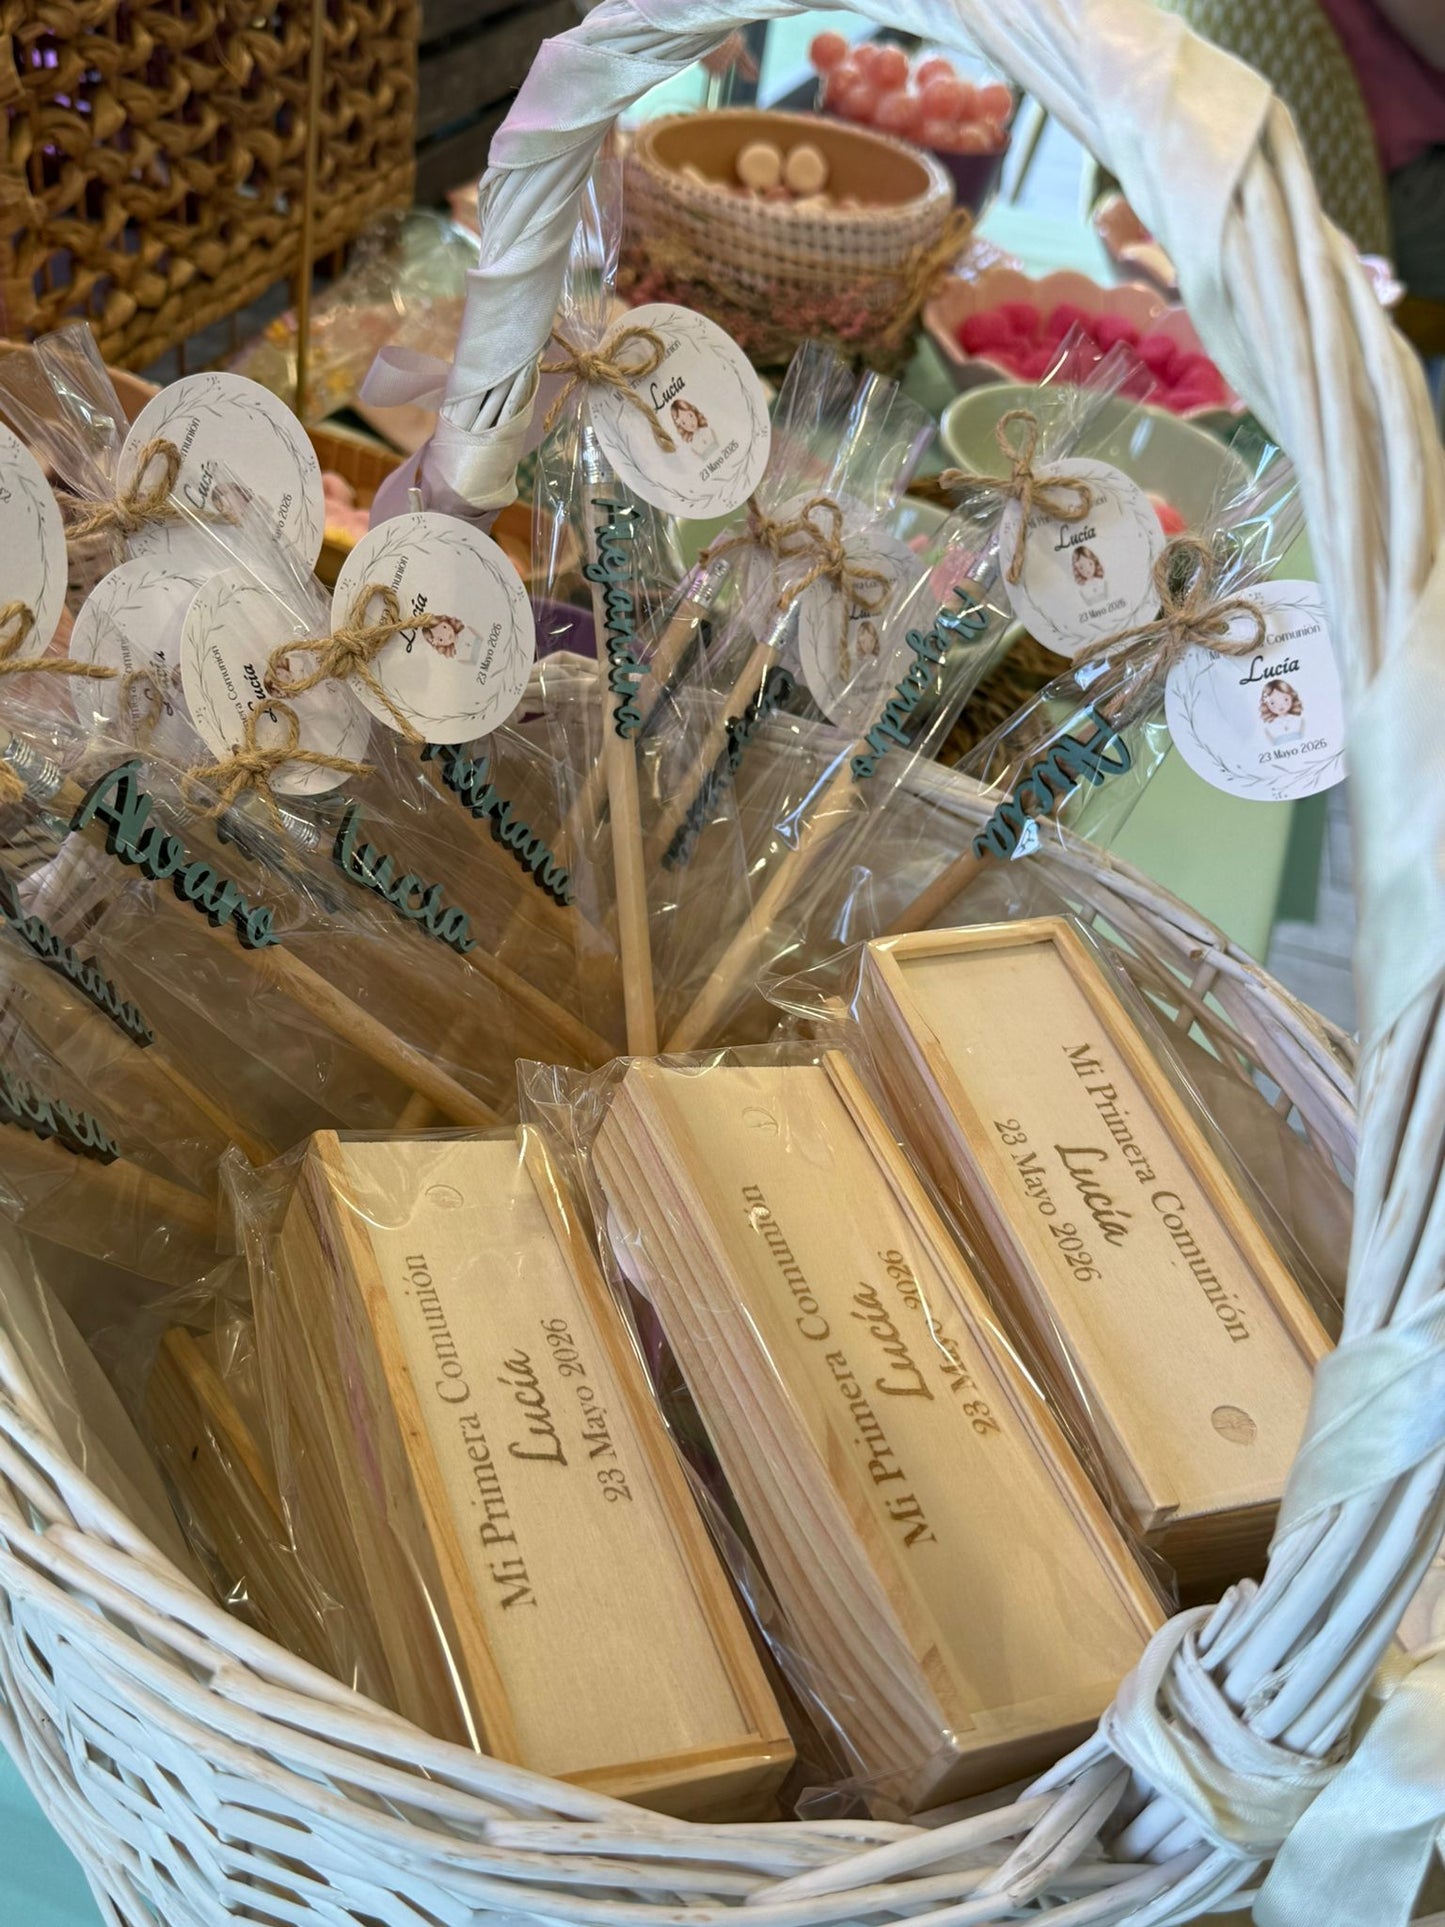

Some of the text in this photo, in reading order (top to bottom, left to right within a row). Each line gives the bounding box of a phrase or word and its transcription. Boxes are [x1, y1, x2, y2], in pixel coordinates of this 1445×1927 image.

[650, 376, 685, 413] Lucía
[179, 417, 201, 458] munión
[280, 493, 293, 520] 2026
[1054, 524, 1097, 551] Lucía
[390, 555, 409, 593] munión
[398, 593, 428, 653] Lcía
[582, 498, 650, 740] Alejandra
[1266, 623, 1321, 645] Comunión
[211, 645, 238, 701] Comunión
[476, 622, 502, 686] 23 Mayo 2026
[1239, 655, 1300, 685] Lucía
[1258, 738, 1328, 764] 23 Mayo 2026
[994, 1117, 1103, 1284] 23 Mayo 2026
[1054, 1142, 1133, 1248] Lucía
[1062, 1040, 1252, 1345] Mi Primera Comunión
[741, 1183, 938, 1549] Mi Primera Comunión
[849, 1280, 936, 1403] Lucía
[876, 1248, 1001, 1436] 23 Mayo 2026
[404, 1253, 538, 1610] Mi Primera Comunión
[496, 1348, 568, 1467] Lucía
[540, 1318, 633, 1504] 23 Mayo 2026
